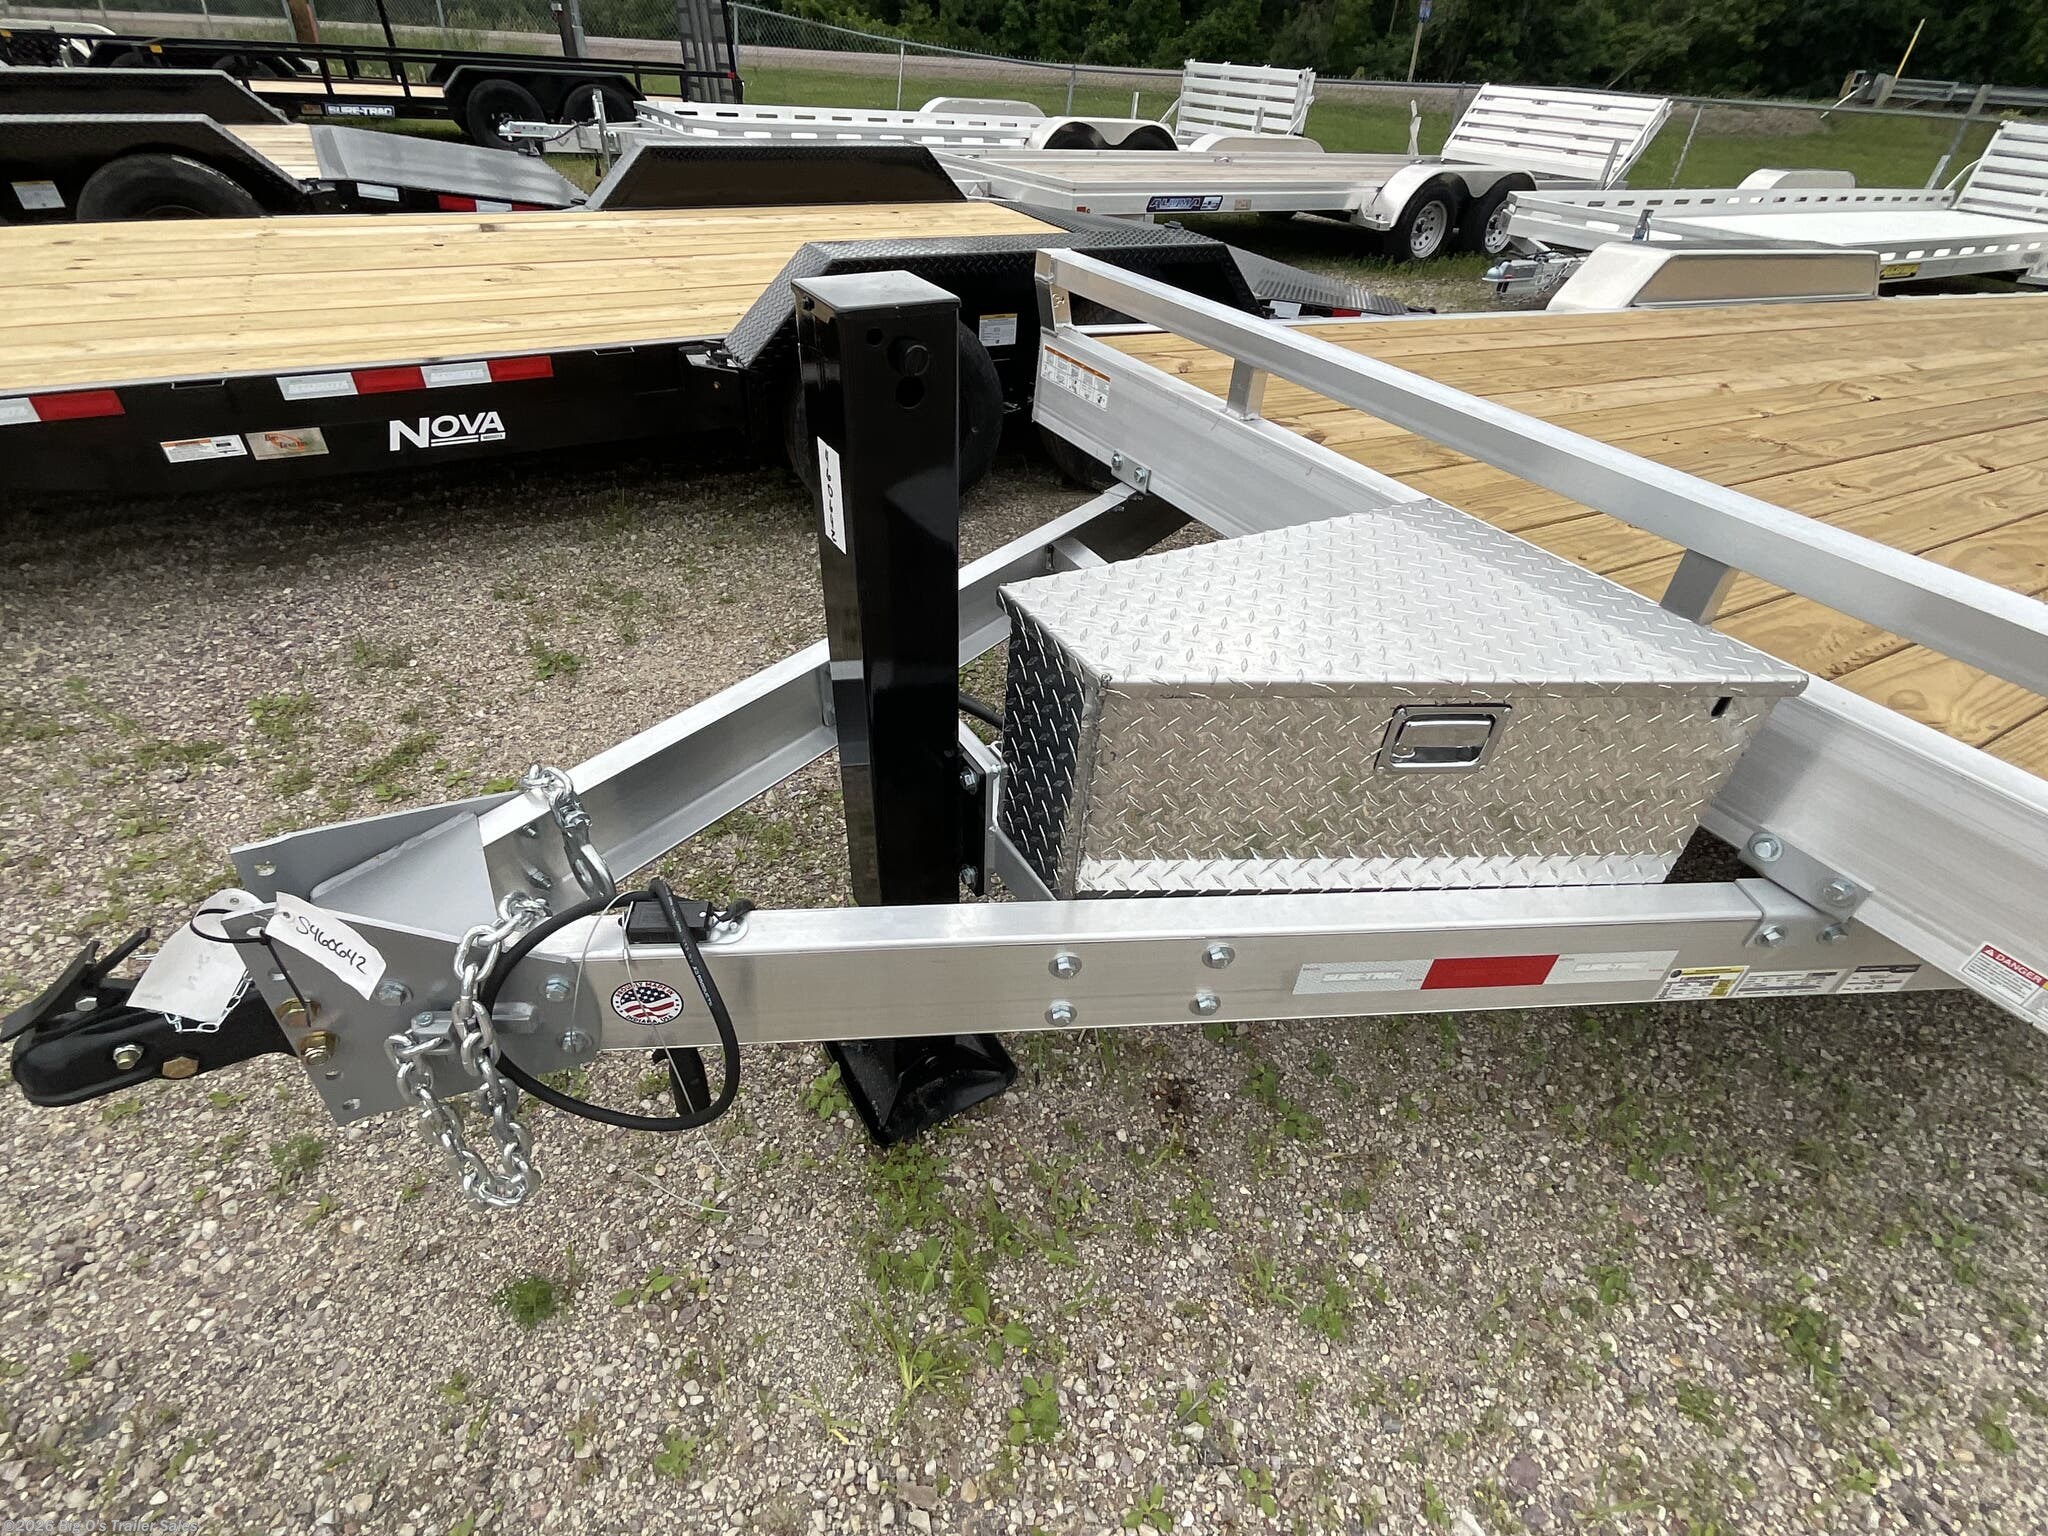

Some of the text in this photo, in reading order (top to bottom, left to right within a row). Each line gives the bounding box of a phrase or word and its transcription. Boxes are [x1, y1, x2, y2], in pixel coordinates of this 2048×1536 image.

[327, 105, 393, 116] SURE-TRAC
[1149, 198, 1201, 210] ALUMA
[389, 411, 505, 451] NOVA
[296, 915, 367, 976] S460642
[1995, 953, 2043, 984] DANGER
